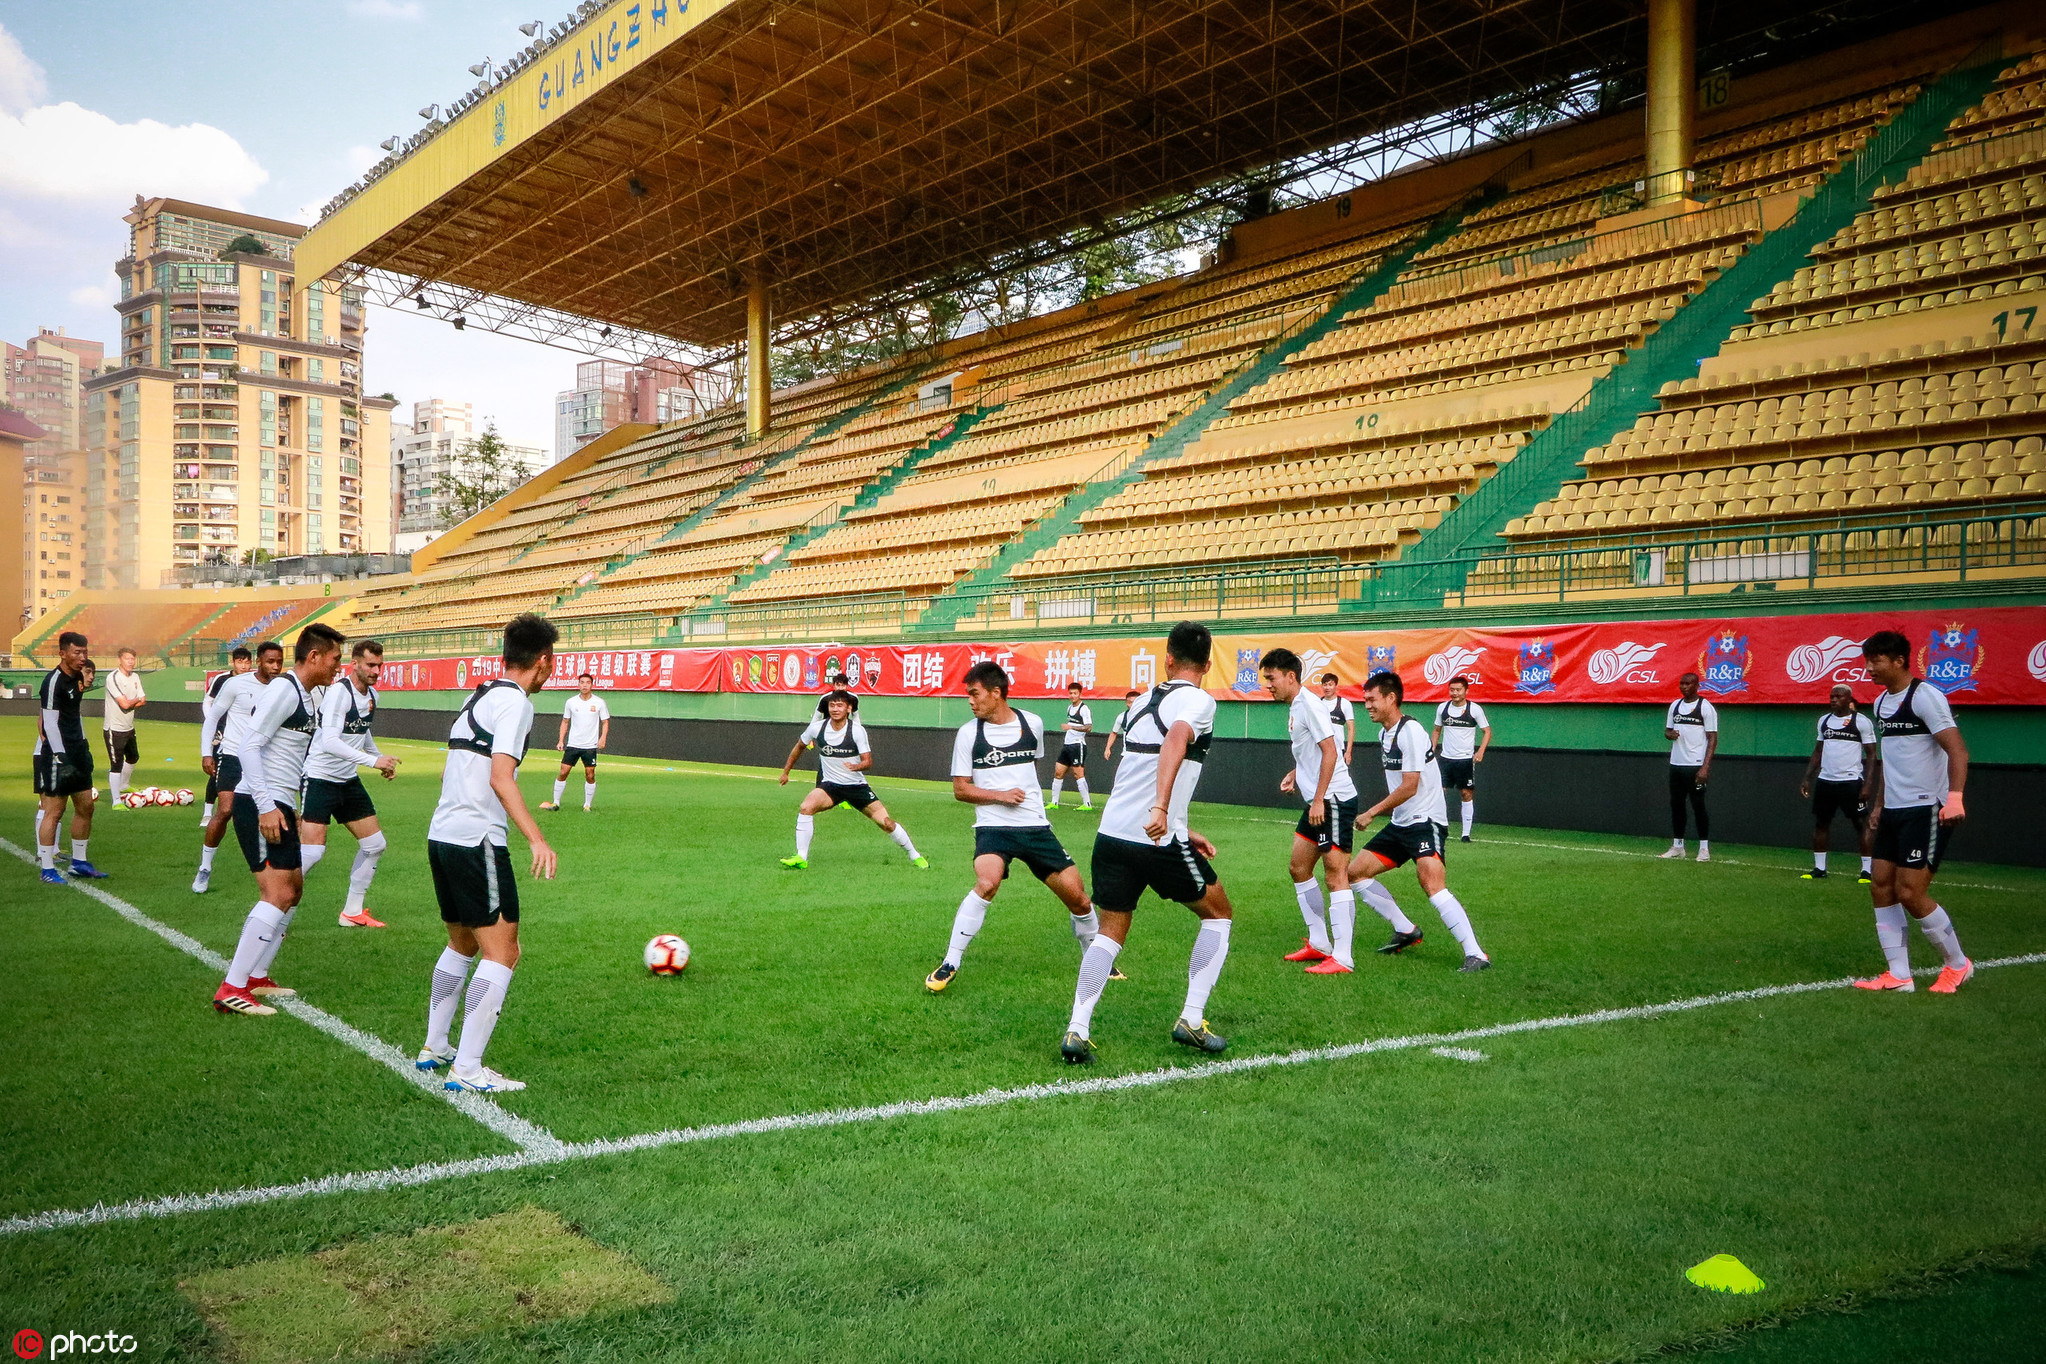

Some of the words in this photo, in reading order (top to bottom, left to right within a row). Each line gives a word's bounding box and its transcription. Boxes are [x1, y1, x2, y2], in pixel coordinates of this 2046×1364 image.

[1702, 75, 1728, 107] 18
[1335, 198, 1351, 219] 19
[1991, 305, 2038, 344] 17
[325, 584, 331, 597] B
[903, 651, 944, 689] 团结
[1044, 649, 1097, 690] 拼搏
[1130, 647, 1156, 689] 向
[1237, 670, 1258, 683] R&F
[1521, 667, 1550, 682] R&F
[1707, 664, 1742, 680] R&F
[1831, 667, 1872, 683] CSL
[1928, 660, 1971, 678] R&F
[1626, 670, 1660, 684] CSL
